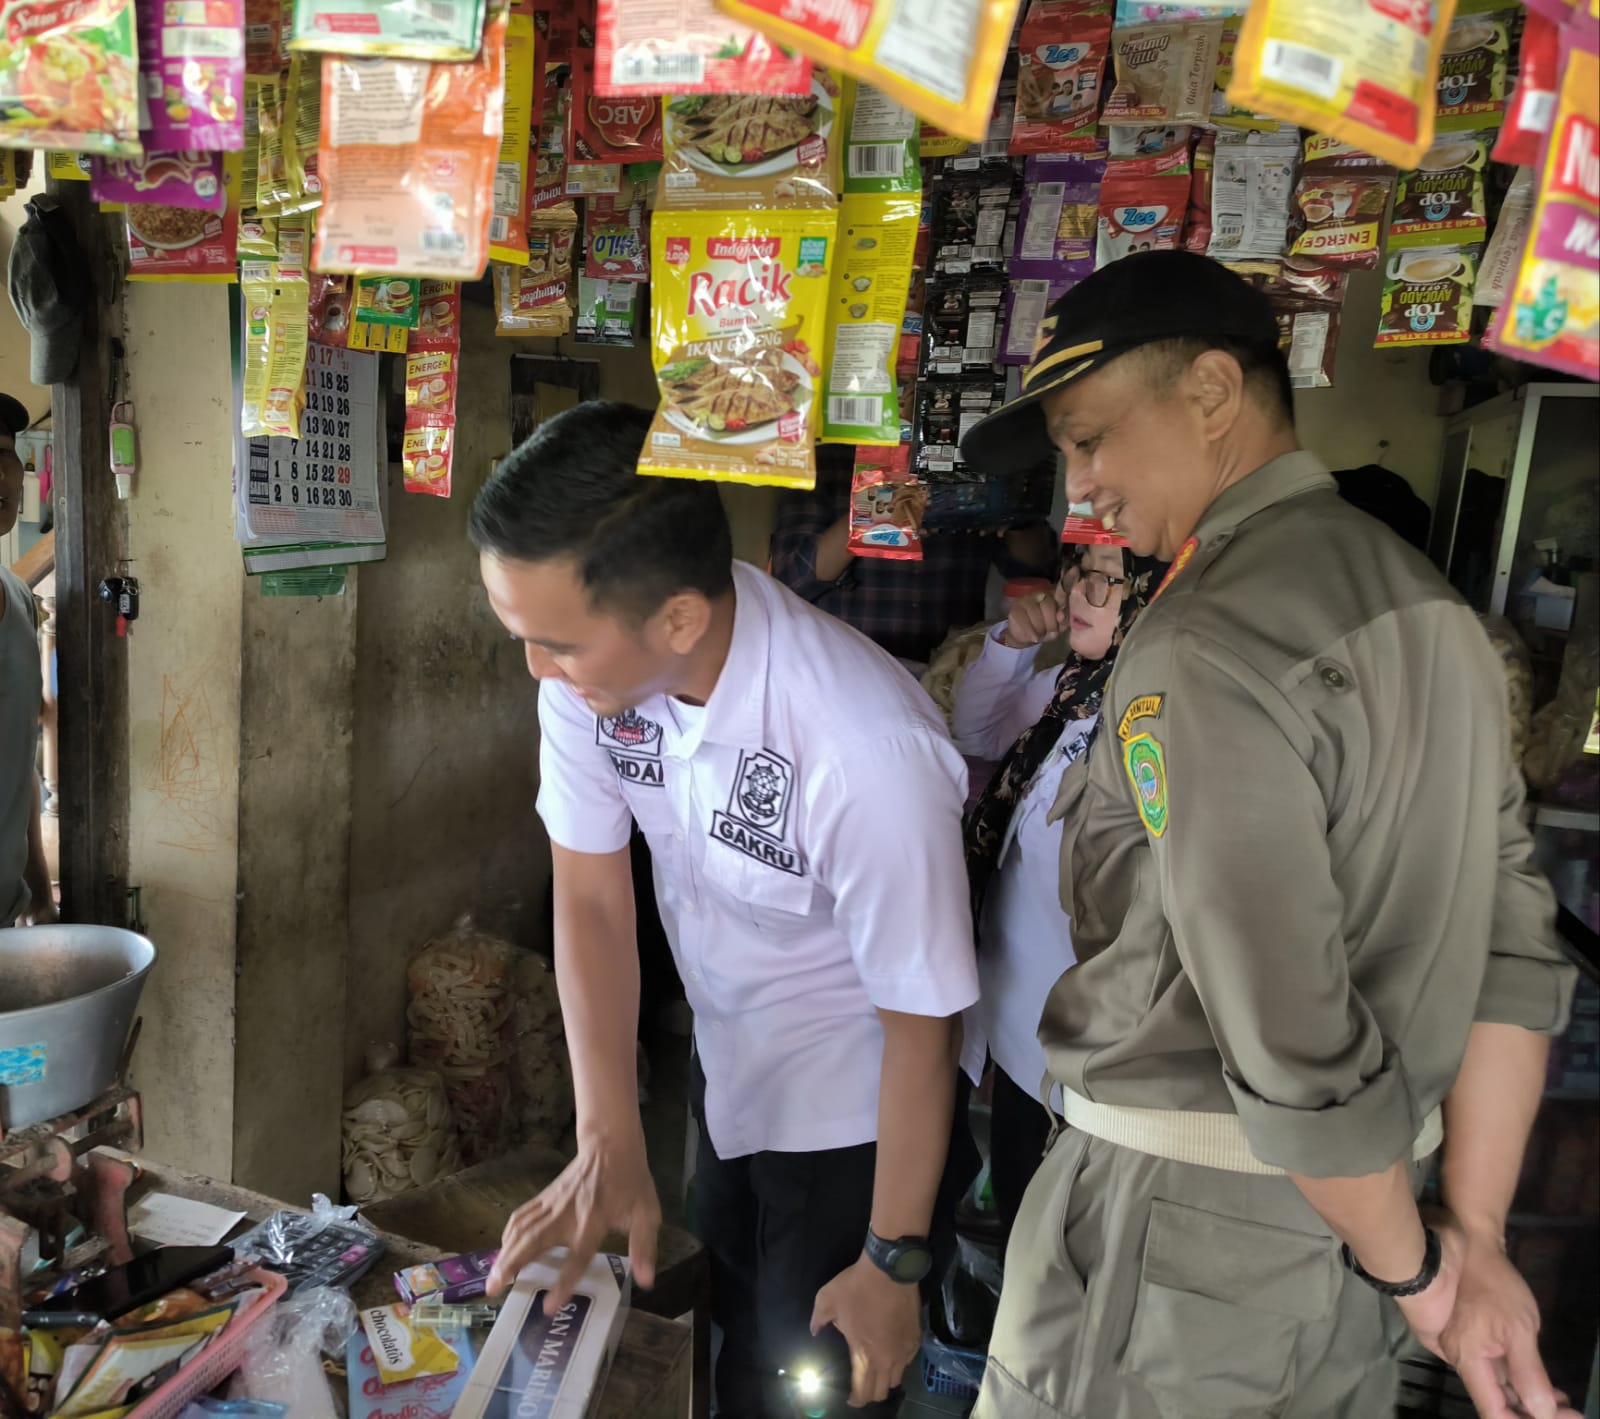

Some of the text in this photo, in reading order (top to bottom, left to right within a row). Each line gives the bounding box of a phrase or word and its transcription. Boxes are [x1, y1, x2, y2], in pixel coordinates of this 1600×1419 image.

[1046, 45, 1079, 63] Zee
[1440, 58, 1486, 75] AVOCAD
[1437, 72, 1478, 91] TOP
[598, 104, 647, 125] ABC
[1414, 176, 1469, 193] AVOCADO
[1419, 191, 1461, 206] TOP
[1122, 208, 1157, 226] Zee
[1445, 220, 1452, 228] 2
[1405, 221, 1442, 232] EXTRA
[1296, 230, 1371, 249] ENERGEN
[421, 281, 452, 296] ERGEN
[687, 263, 792, 317] Racik
[1399, 288, 1453, 304] AVOCADO
[1404, 302, 1445, 318] TOP
[1393, 331, 1427, 341] EXTRA
[1431, 331, 1439, 339] 2
[308, 345, 316, 363] 0
[320, 347, 334, 367] 17
[686, 340, 724, 358] IKAN
[409, 359, 449, 375] ENERGEN
[305, 368, 349, 393] 11 18 25
[306, 392, 350, 416] 12 19 26
[306, 416, 350, 438] 13 20 27
[291, 439, 351, 461] 7 14 21 28
[274, 460, 351, 484] 1 8 15 22 29
[274, 483, 352, 506] 2 9 16 23 30
[719, 820, 795, 869] GAKRU
[548, 1303, 578, 1337] SAN
